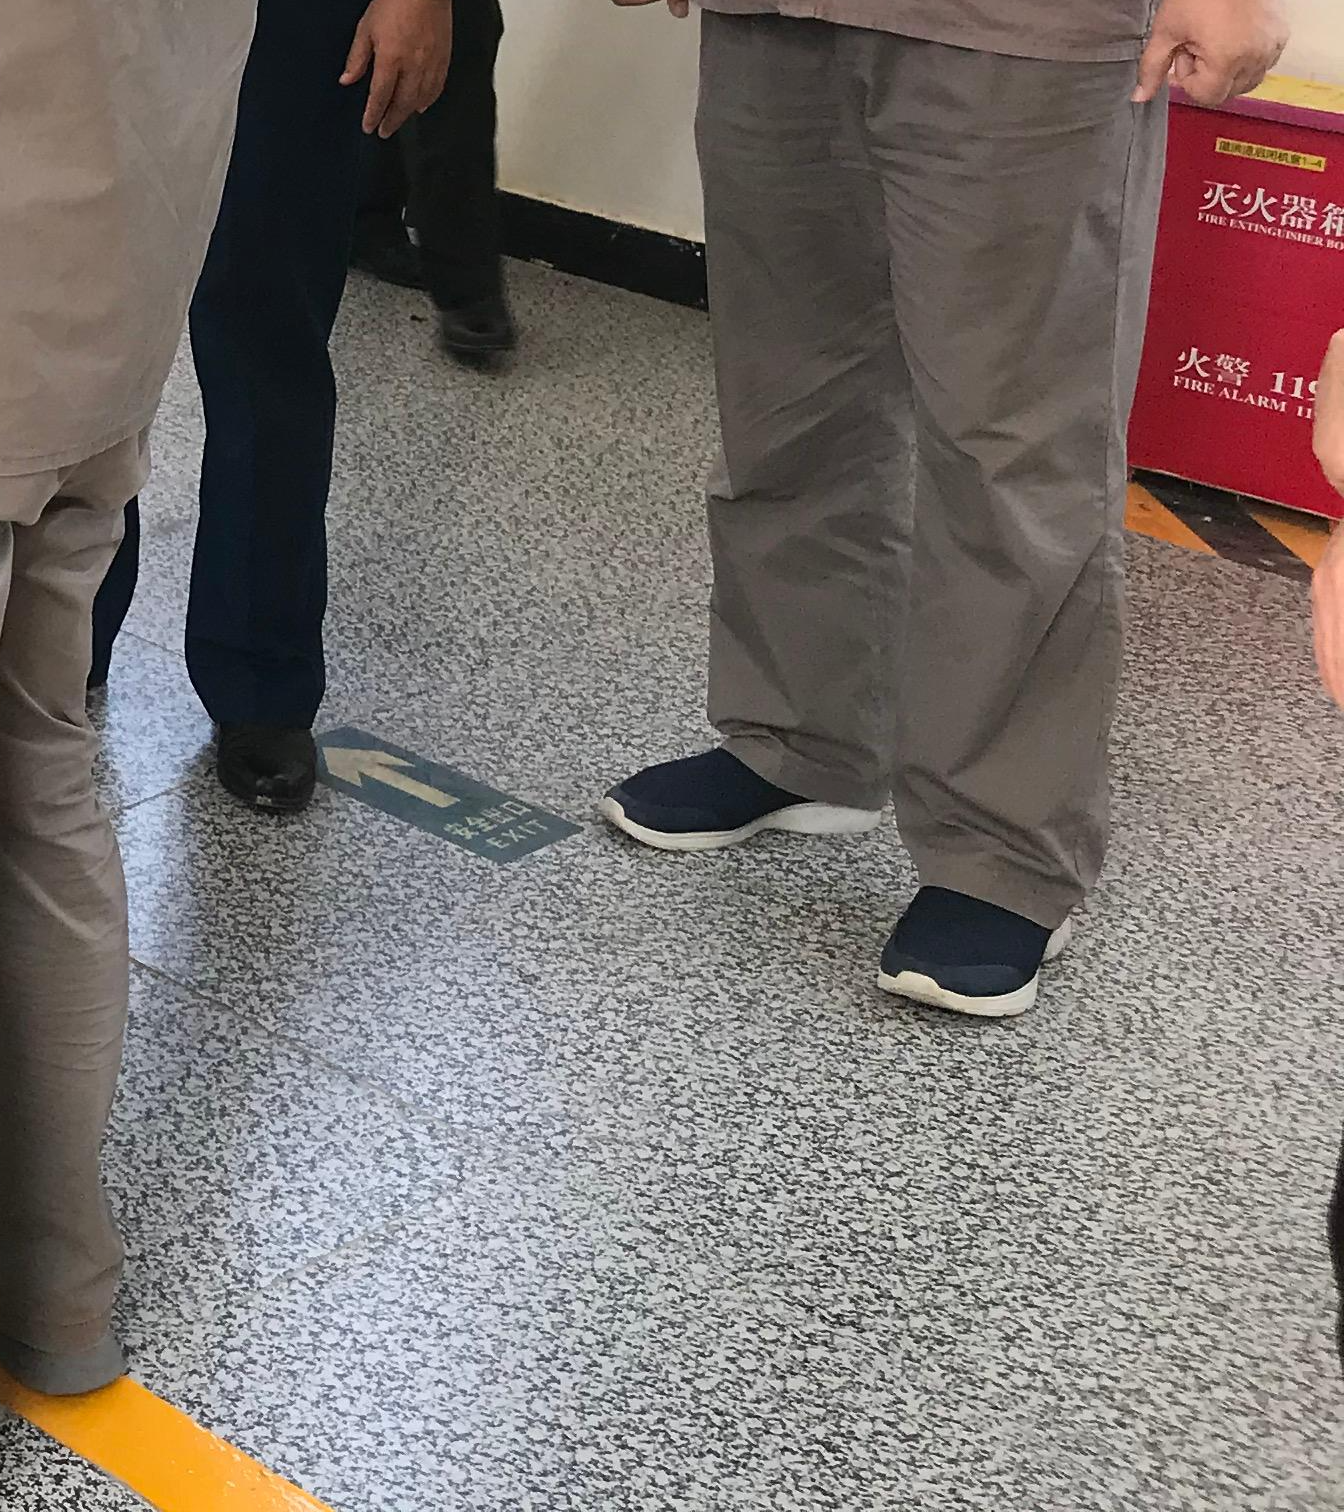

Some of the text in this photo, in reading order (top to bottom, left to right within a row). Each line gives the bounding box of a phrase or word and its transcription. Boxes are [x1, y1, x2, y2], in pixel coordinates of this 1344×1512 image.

[1198, 180, 1344, 237] 灭火器箱
[1198, 212, 1344, 251] FIRE EXTINGUISHER BO
[1174, 346, 1250, 386] 火警
[1173, 375, 1313, 420] FIRE ALARM 11
[486, 819, 548, 849] EXIT
